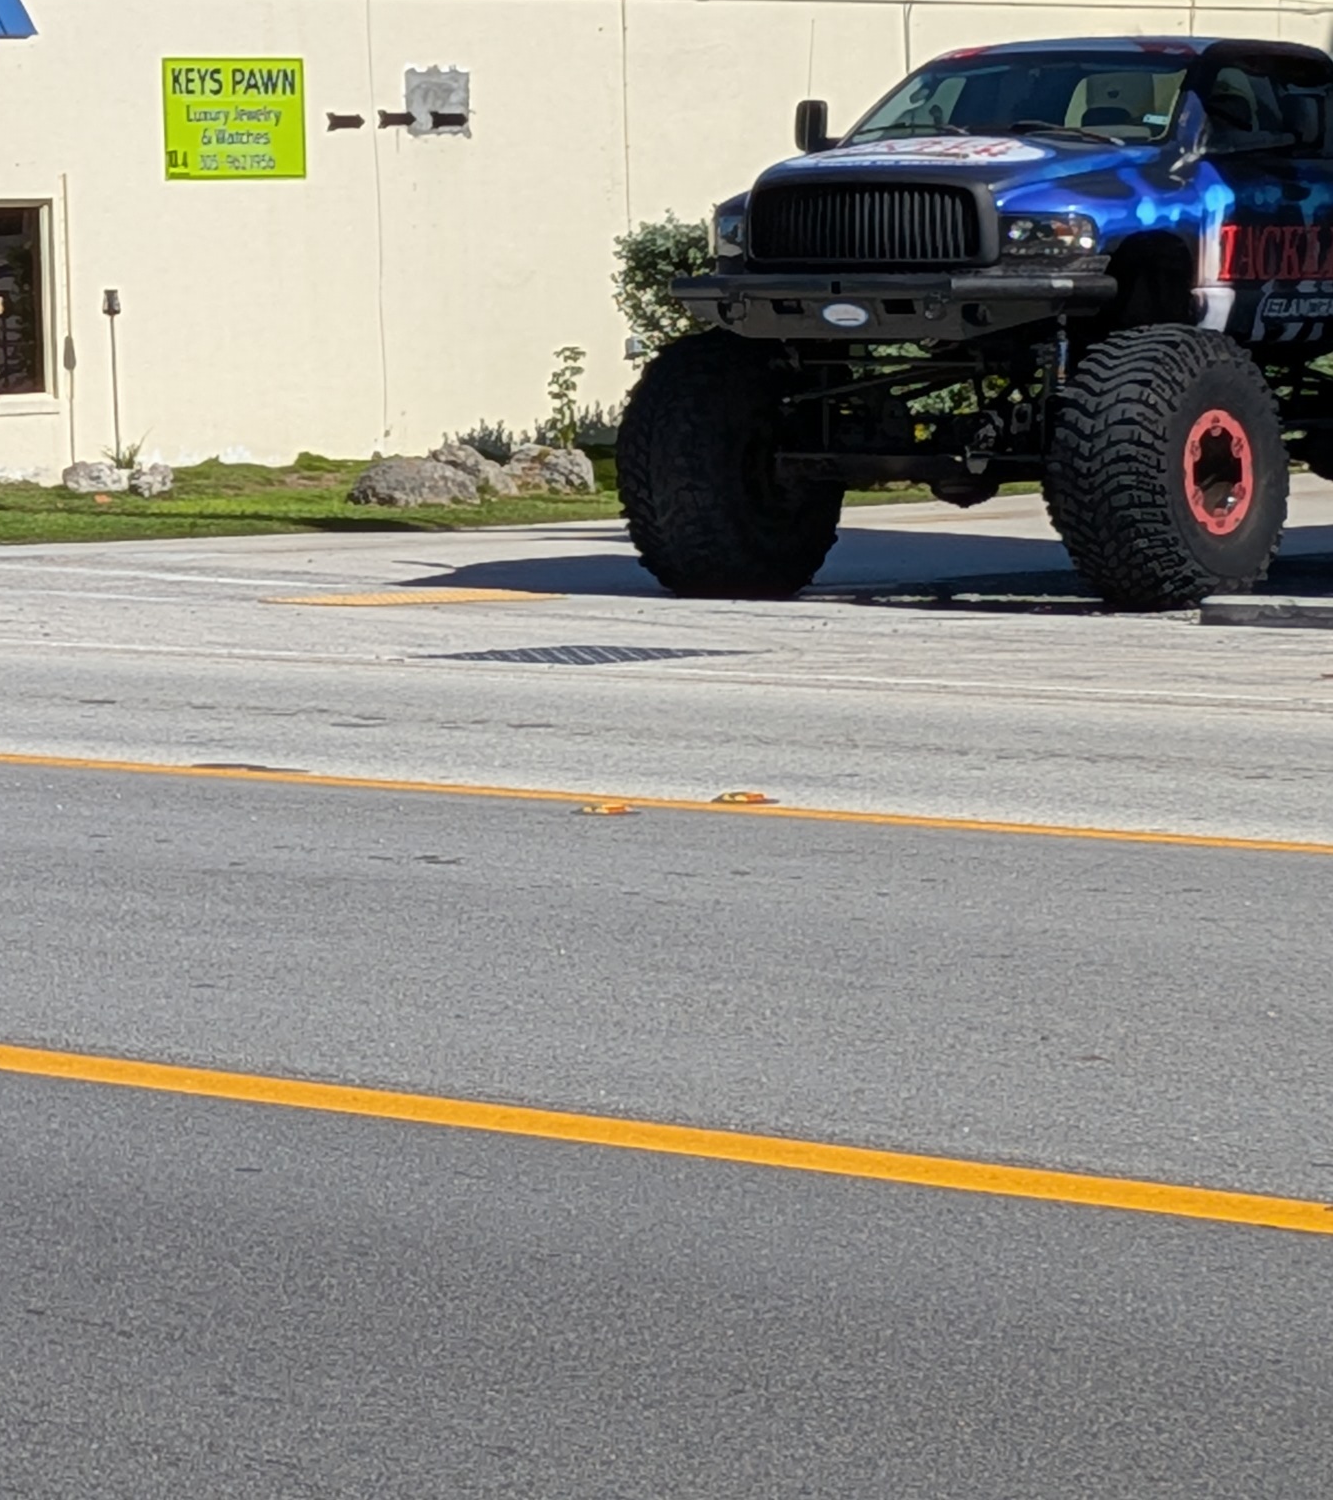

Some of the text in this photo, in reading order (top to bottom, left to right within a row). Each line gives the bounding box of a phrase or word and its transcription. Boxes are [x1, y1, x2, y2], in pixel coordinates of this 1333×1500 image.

[171, 67, 295, 95] KEYS PAWN
[186, 105, 282, 126] Luxury Jewelry
[215, 128, 270, 145] Watches
